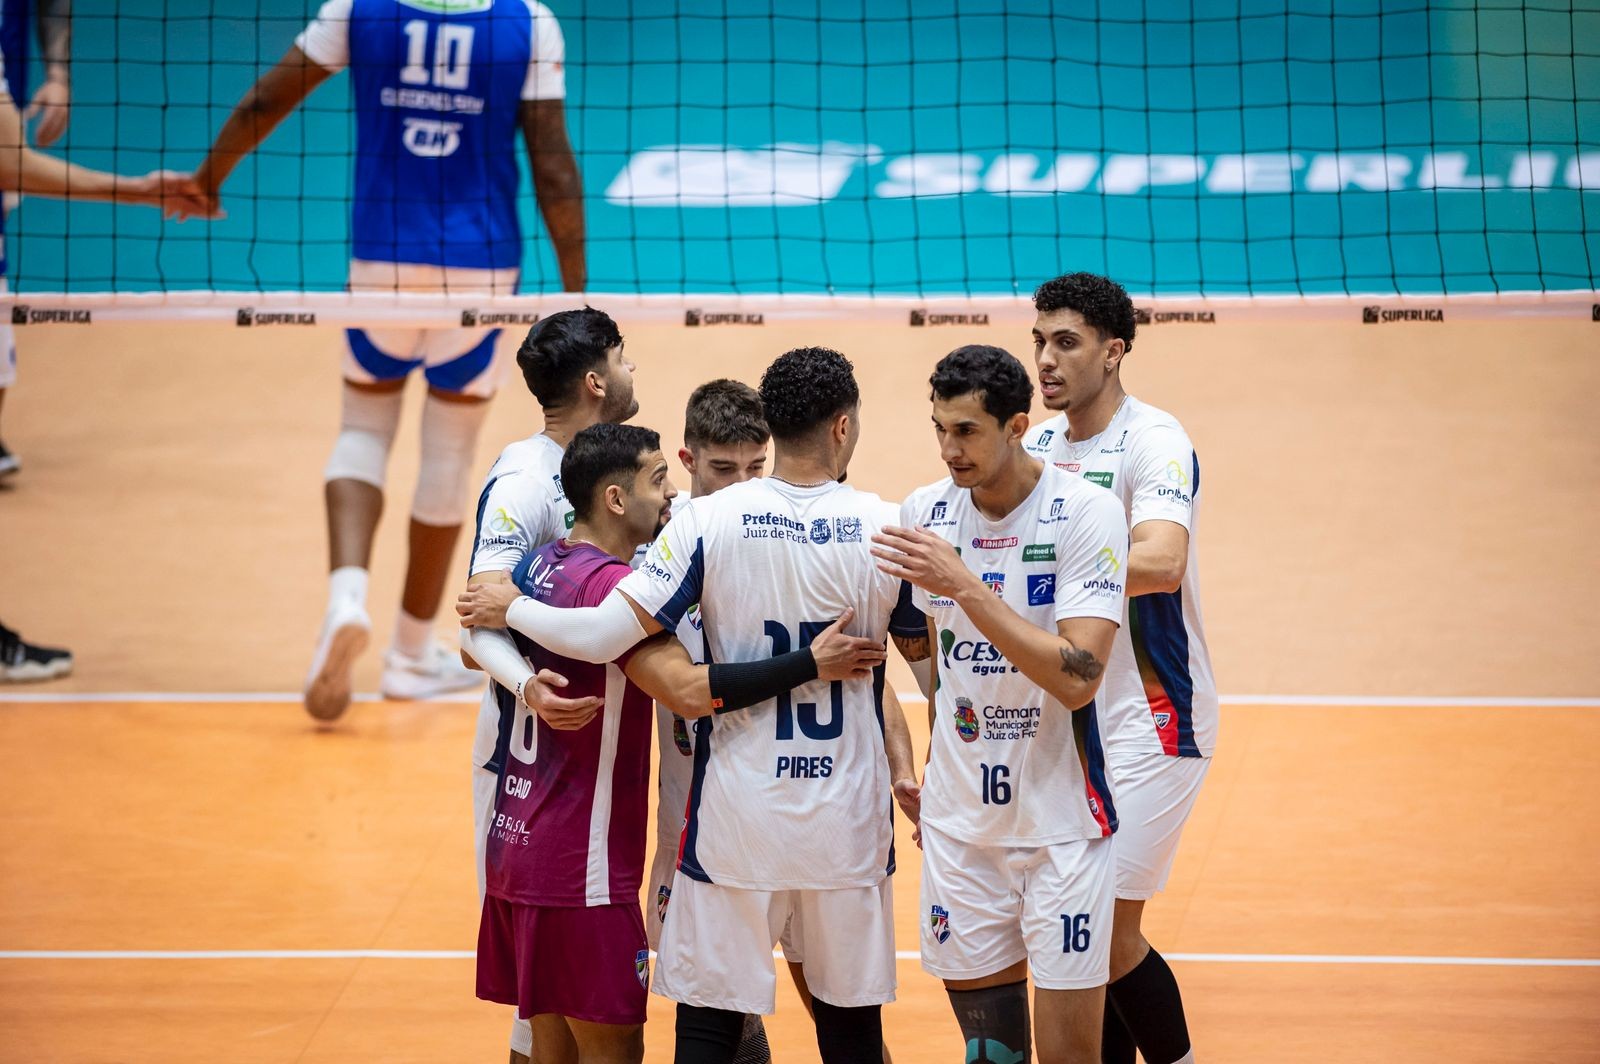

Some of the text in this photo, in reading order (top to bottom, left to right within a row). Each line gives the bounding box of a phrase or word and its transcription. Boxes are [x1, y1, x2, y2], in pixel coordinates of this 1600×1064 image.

[400, 19, 475, 90] 10
[30, 308, 92, 324] SUPERLIGA
[255, 311, 317, 326] SUPERLIGA
[703, 312, 765, 326] SUPERLIGA
[928, 312, 990, 326] SUPERLIGA
[1154, 310, 1217, 324] SUPERLIGA
[1381, 308, 1445, 323] SUPERLIGA
[742, 512, 806, 531] Prefeitura
[744, 527, 808, 544] Juiz de Fora
[1083, 578, 1122, 594] uniben
[953, 641, 1003, 662] CES
[972, 663, 1006, 676] água
[764, 620, 844, 740] 15
[986, 719, 1032, 731] Municipal
[984, 730, 1007, 741] Juiz
[1008, 729, 1020, 740] de
[776, 756, 833, 779] PIRES
[980, 762, 1012, 806] 16
[1060, 913, 1092, 954] 16
